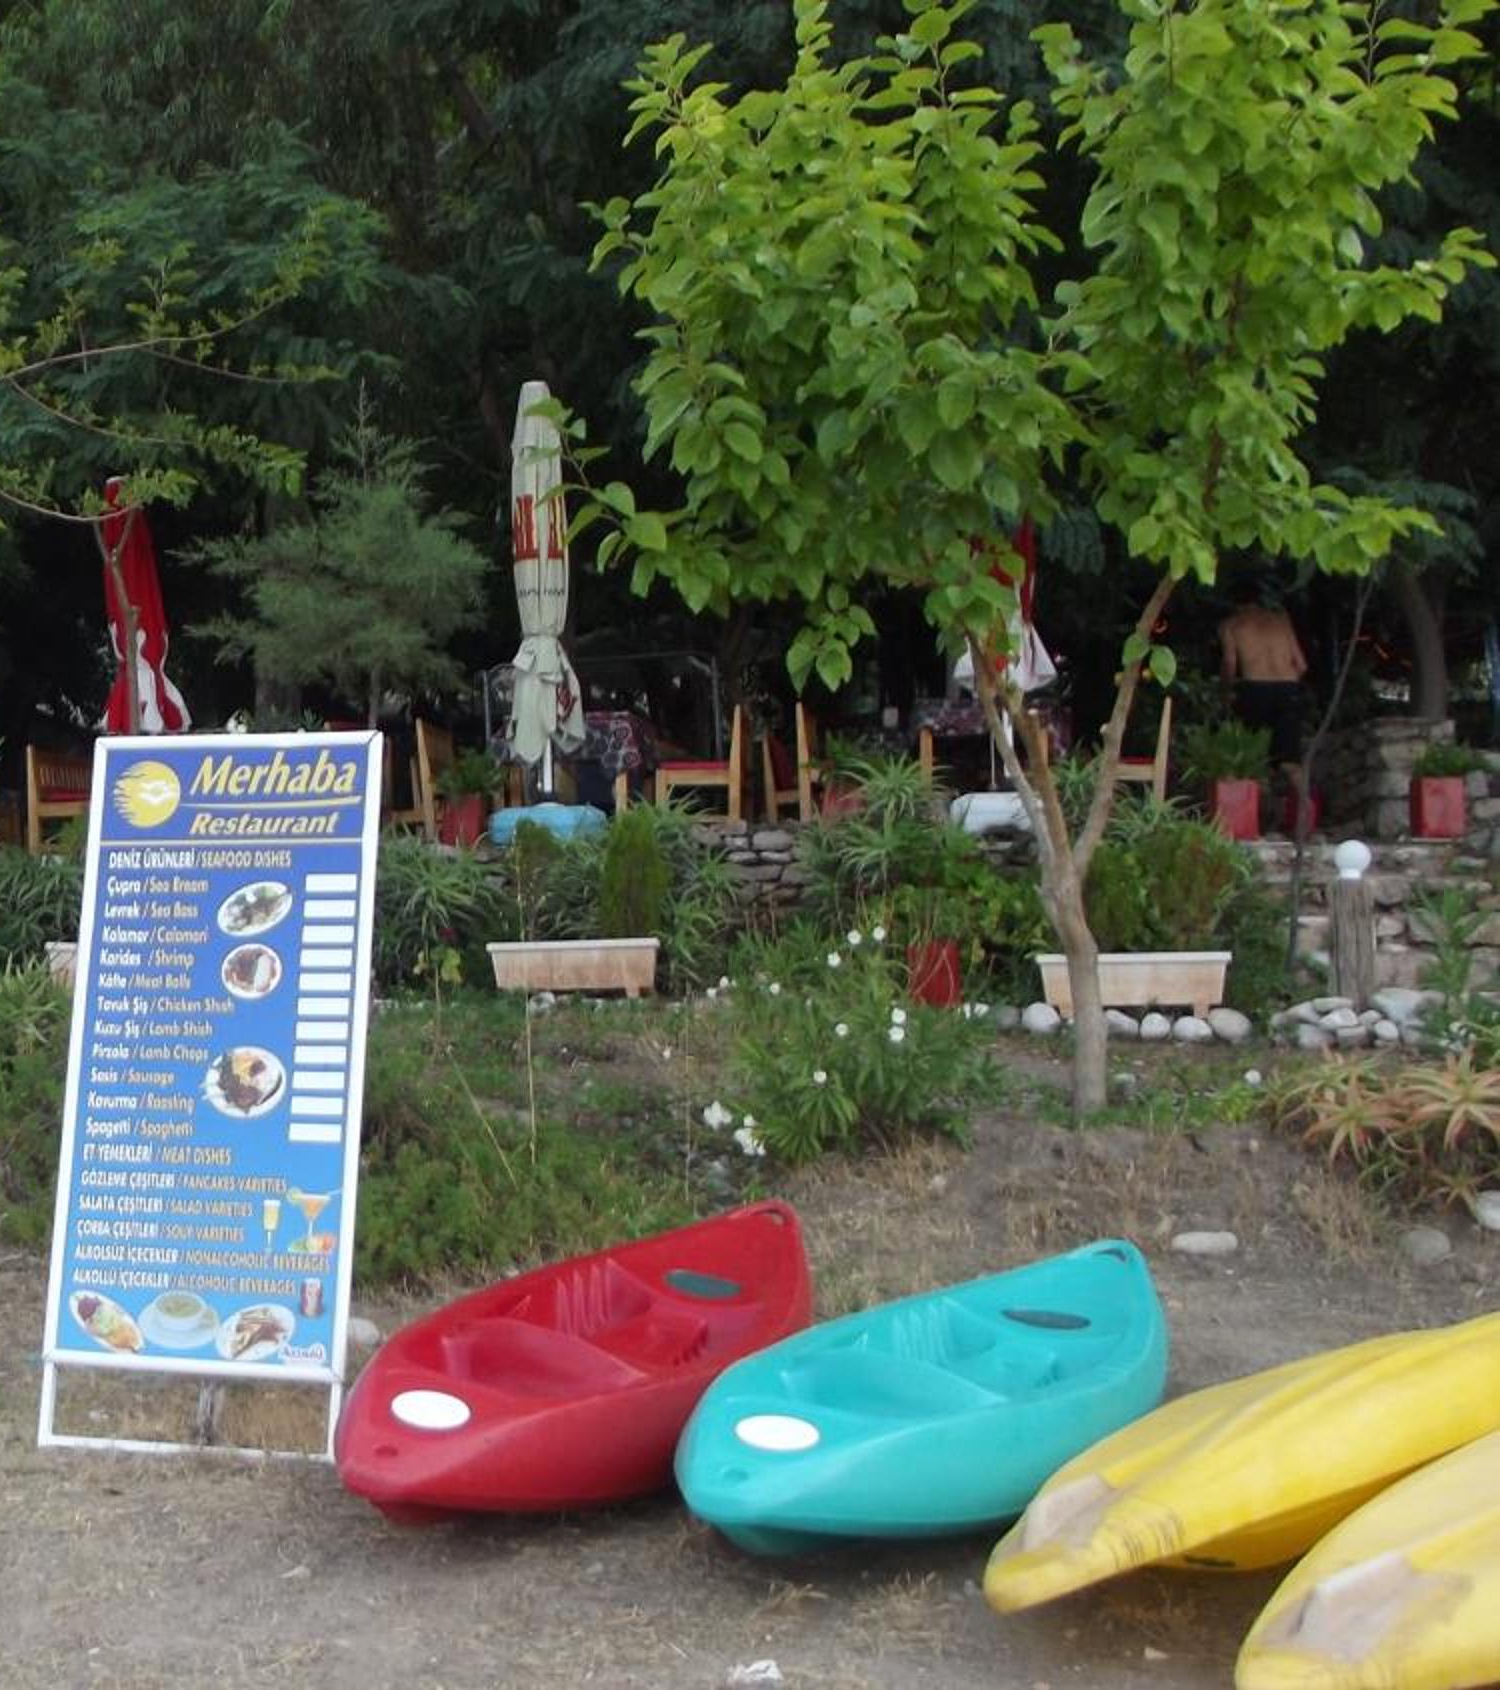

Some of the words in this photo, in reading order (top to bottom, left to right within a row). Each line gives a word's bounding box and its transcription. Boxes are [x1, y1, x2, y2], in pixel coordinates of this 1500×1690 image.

[190, 750, 357, 795] Merhaba
[189, 811, 340, 836] Restaurant
[254, 850, 292, 868] DISHES
[149, 876, 170, 893] Sea
[104, 901, 140, 918] Levrek
[150, 901, 171, 918] Sea
[172, 902, 199, 918] Bass
[101, 925, 149, 942] Kalamar
[99, 949, 142, 966] Karides
[154, 949, 196, 970] Shrimp
[97, 995, 130, 1012] Tavuk
[157, 996, 201, 1013] Chicken
[149, 1021, 181, 1036] Lamb
[182, 1021, 213, 1037] Shish
[92, 1043, 129, 1060] Pirzola
[139, 1044, 171, 1061] Lamb
[172, 1045, 209, 1064] Chops
[87, 1090, 137, 1109] Kavurma
[86, 1115, 131, 1138] Spagetti
[139, 1116, 194, 1140] Spaghetti
